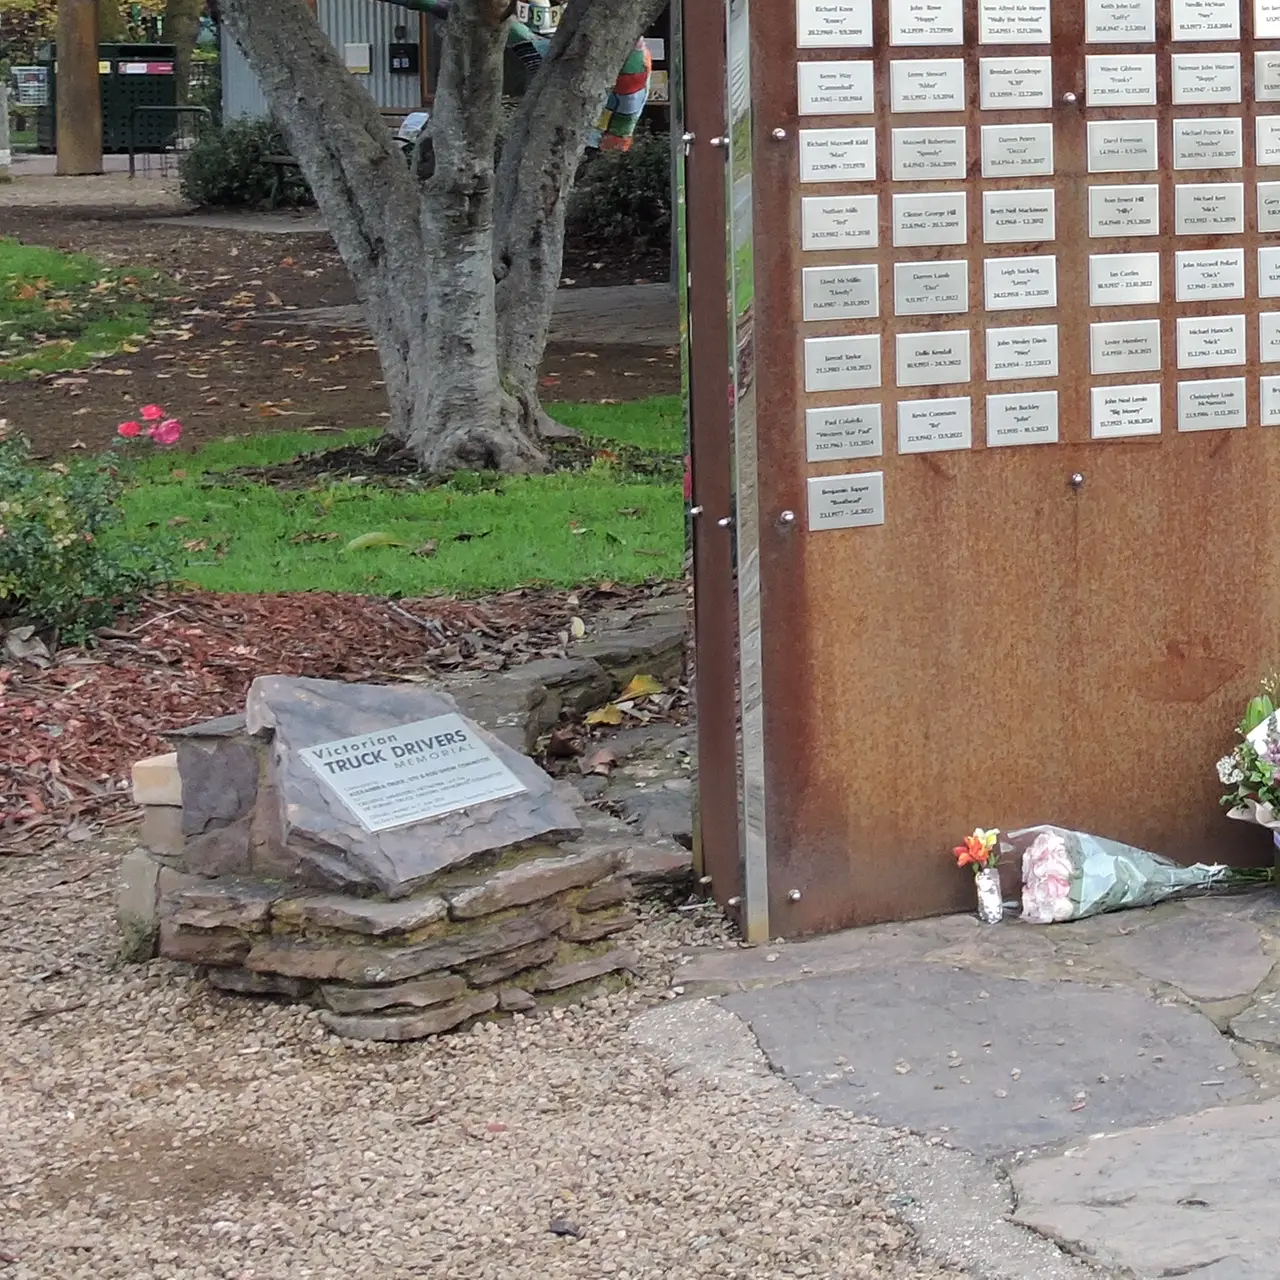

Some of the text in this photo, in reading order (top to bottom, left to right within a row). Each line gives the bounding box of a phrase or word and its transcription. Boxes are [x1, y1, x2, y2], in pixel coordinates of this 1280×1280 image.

[312, 734, 398, 759] Victorian
[324, 729, 467, 774] TRUCK DRIVERS
[394, 744, 476, 769] MEMORIAL
